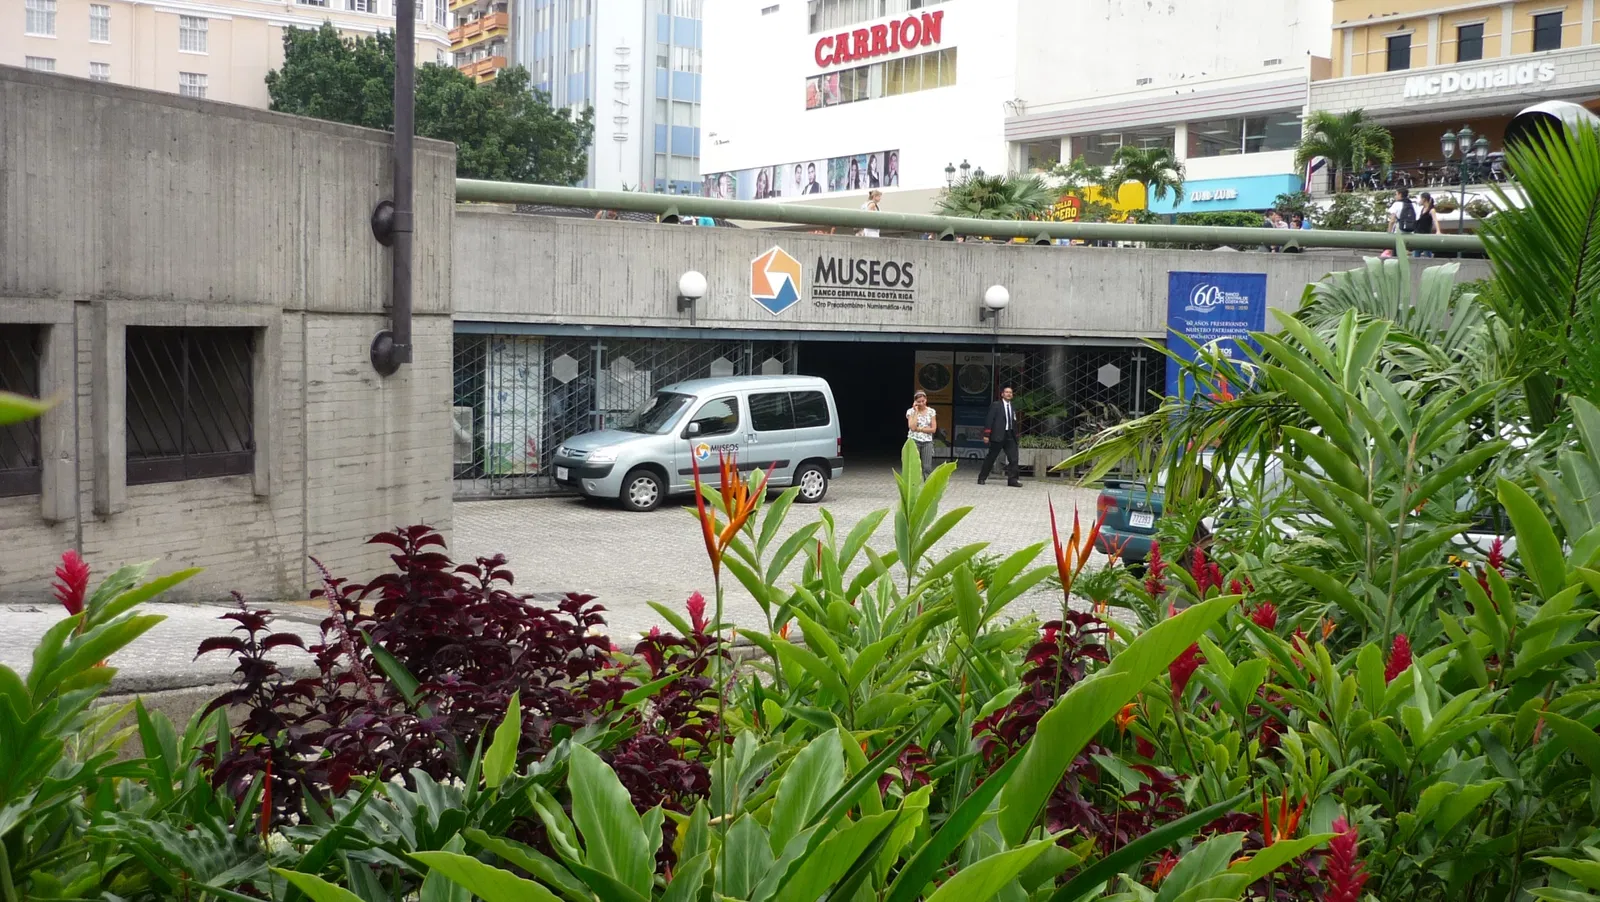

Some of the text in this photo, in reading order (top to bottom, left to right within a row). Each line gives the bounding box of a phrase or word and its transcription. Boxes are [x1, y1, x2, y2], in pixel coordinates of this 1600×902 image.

[1404, 61, 1556, 98] McDonald's
[815, 256, 914, 288] MUSEOS
[837, 290, 866, 298] CENTRAL
[1194, 284, 1219, 306] 60
[710, 444, 738, 452] MUSEOS
